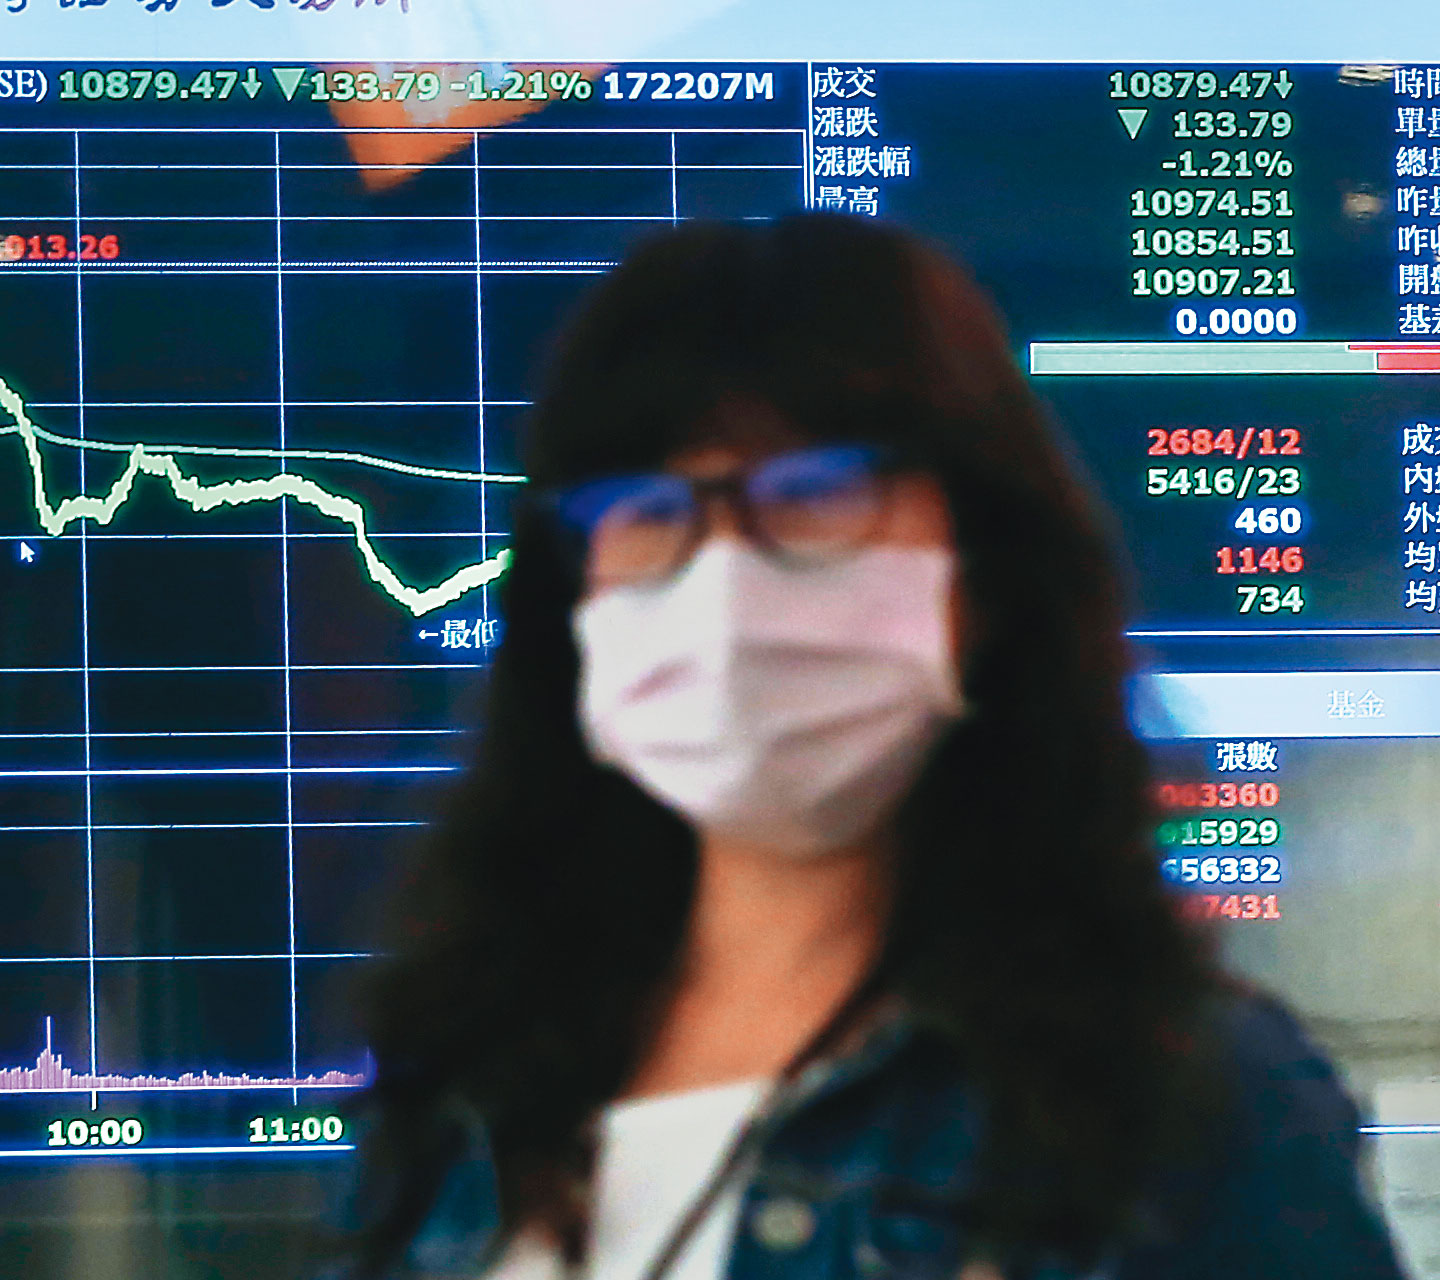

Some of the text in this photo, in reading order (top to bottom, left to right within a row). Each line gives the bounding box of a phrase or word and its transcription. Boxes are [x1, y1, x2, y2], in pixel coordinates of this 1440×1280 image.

[59, 70, 238, 100] 10879.47
[310, 73, 440, 101] 133.79
[450, 72, 591, 100] -1.21%
[604, 72, 774, 100] 172207M
[813, 67, 876, 99] 成交
[1109, 72, 1272, 99] 10879.47
[814, 106, 878, 138] 漲跌
[1174, 111, 1292, 138] 133.79
[814, 145, 911, 178] 漲跌幅
[1162, 151, 1293, 178] -1.21%
[1131, 190, 1293, 217] 10974.51
[1132, 229, 1294, 257] 10854.51
[1132, 269, 1295, 296] 10907.21
[1175, 308, 1297, 335] 0.0000
[1147, 428, 1301, 459] 2684/12
[1147, 468, 1300, 499] 5416/23
[1235, 507, 1302, 534] 460
[1217, 546, 1303, 574] 1146
[1237, 586, 1303, 613] 734
[1327, 690, 1385, 719] 基金
[1216, 741, 1278, 772] 張數
[1158, 819, 1280, 845] 15929
[48, 1119, 143, 1146] 10:00
[250, 1116, 343, 1143] 11:00
